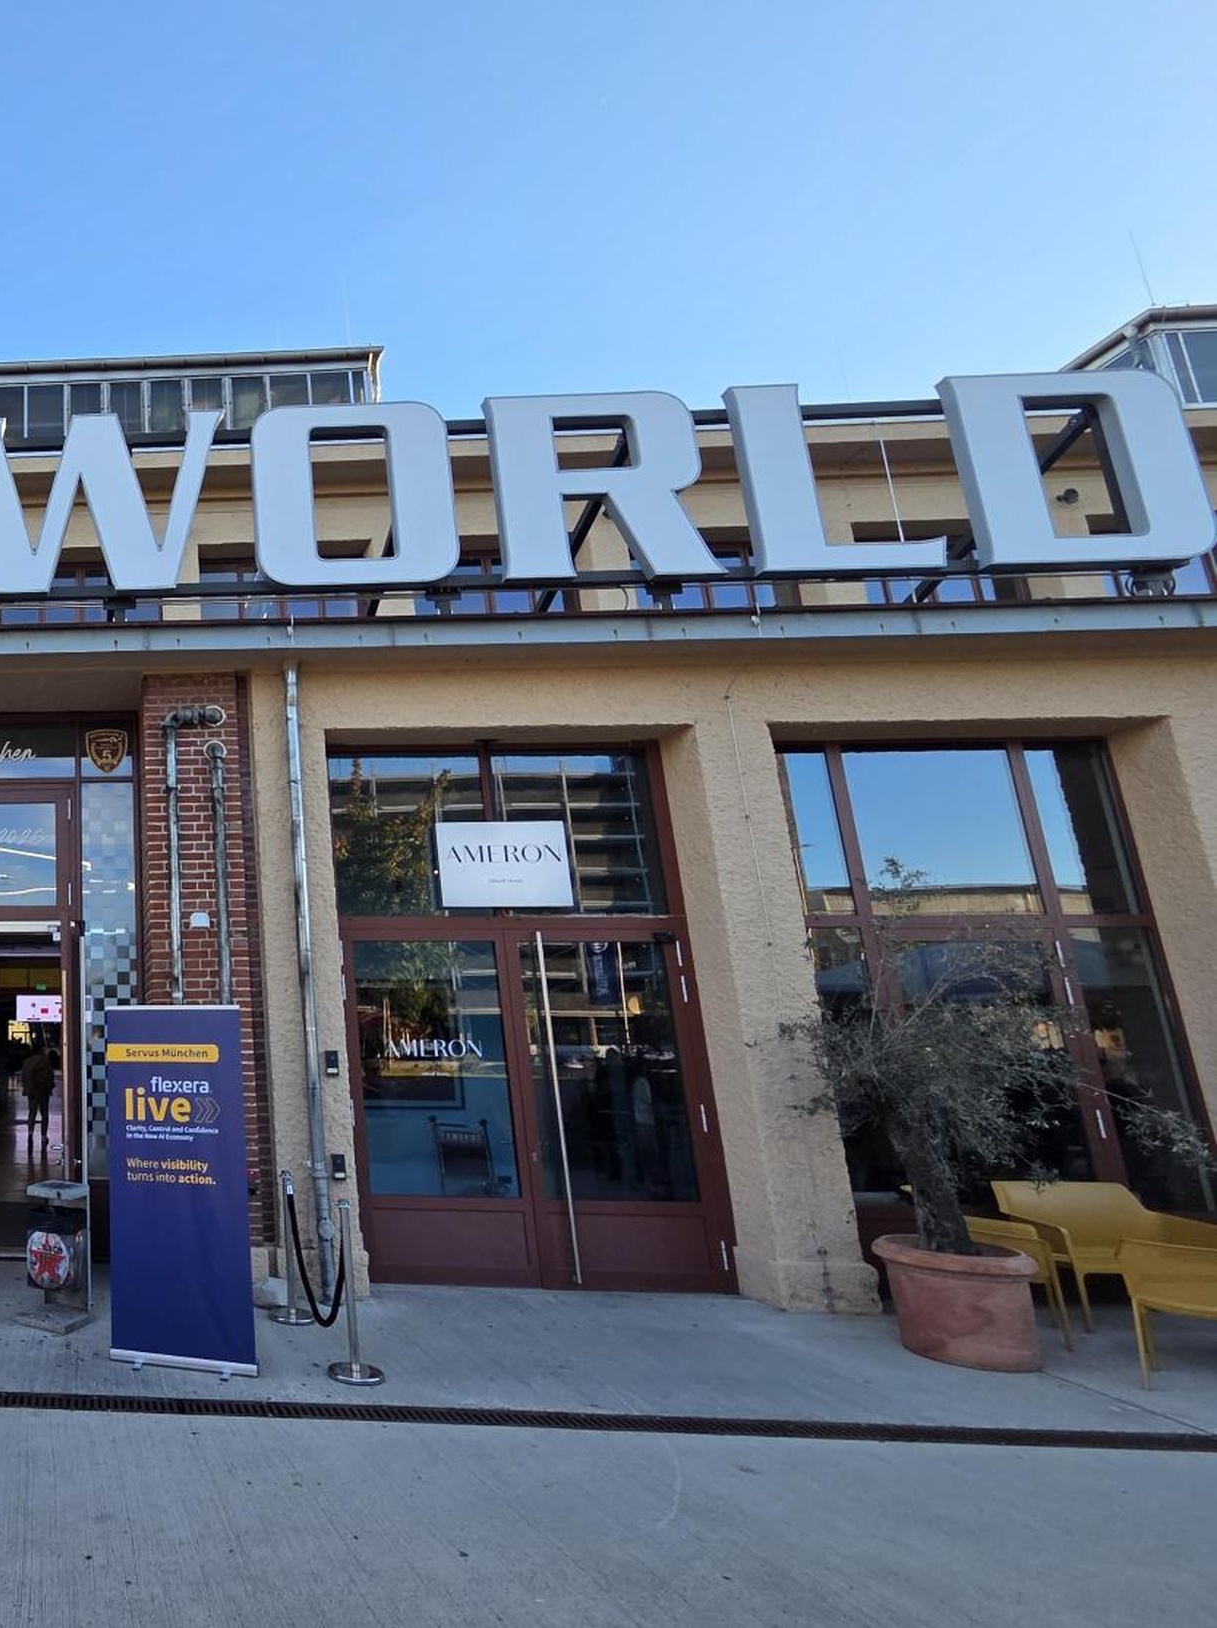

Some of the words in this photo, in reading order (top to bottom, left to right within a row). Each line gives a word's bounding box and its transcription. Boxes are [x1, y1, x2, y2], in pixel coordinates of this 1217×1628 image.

[447, 844, 562, 863] AMERON
[125, 1048, 159, 1058] Servus
[162, 1047, 209, 1058] München
[385, 1039, 483, 1058] AMERON
[150, 1076, 209, 1094] flexera
[125, 1086, 192, 1123] live
[126, 1158, 160, 1169] Where
[161, 1159, 209, 1174] visibility
[126, 1171, 154, 1182] turns
[156, 1172, 177, 1183] into
[178, 1173, 217, 1185] action.
